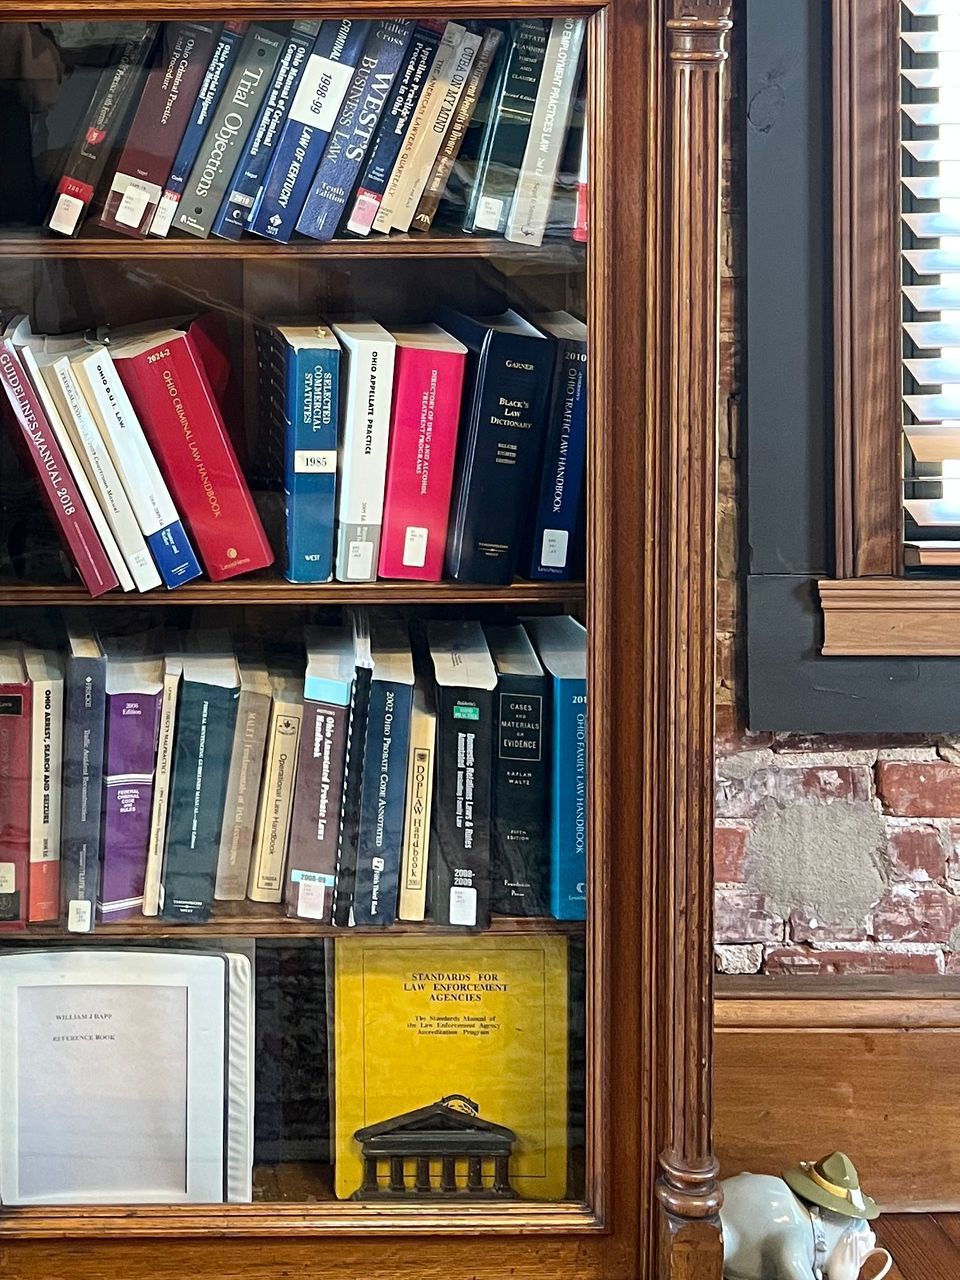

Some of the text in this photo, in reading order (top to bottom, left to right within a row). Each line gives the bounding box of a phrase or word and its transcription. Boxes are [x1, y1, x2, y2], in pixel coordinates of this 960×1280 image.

[208, 41, 224, 71] Practice
[220, 43, 230, 62] Ohio
[328, 18, 352, 62] CRIMINAL
[160, 38, 194, 125] Ohio Criminal Practice
[161, 51, 180, 91] Procedure
[390, 40, 423, 116] Procedure Ohio
[412, 45, 432, 83] Appellate
[249, 42, 296, 156] Complaints and Indictments
[263, 45, 305, 146] Ohio Manual of Criminal
[309, 71, 333, 114] 1998-99
[324, 53, 378, 164] BUSINESS LAW
[431, 45, 474, 134] CUBA ON MY MIND
[538, 31, 569, 152] EMPLOYMENT PRACTICES LAW
[192, 62, 263, 200] Trial Objections
[344, 66, 393, 163] WEST'S
[386, 59, 444, 197] THE AMERICAN LAWYERS QUARTERLY
[277, 125, 312, 208] LAW OF KENTUCKY
[315, 189, 345, 204] Edition
[321, 181, 345, 196] Tenth
[145, 348, 172, 364] 2024-2
[505, 359, 535, 370] GARNER
[564, 352, 587, 362] 2010
[95, 364, 126, 429] OHIO D.U.I. LAW
[301, 372, 314, 424] STATUTES
[310, 365, 324, 431] COMMERCIAL
[320, 371, 332, 424] SELECTED
[367, 374, 376, 415] APPELLATE
[428, 369, 437, 408] DIRECTORY
[499, 397, 529, 409] BLACK'S
[427, 410, 433, 419] OF
[490, 416, 533, 429] DICTIONARY
[504, 408, 522, 417] LAW
[162, 369, 224, 518] OHIO CRIMINAL LAW HANDBOOK
[364, 419, 372, 454] PRACTICE
[416, 390, 428, 474] TREATMENT PROGRAMS
[551, 368, 577, 512] OHIO TRAFFIC LAW HANDBOOK
[31, 430, 64, 488] MANUAL
[55, 486, 76, 516] 2018
[304, 456, 327, 467] 1985
[420, 460, 428, 495] ALCOHOL
[304, 554, 320, 562] WEST
[385, 691, 394, 711] 2002
[510, 703, 533, 712] CASES
[43, 711, 51, 742] ARREST,
[313, 714, 324, 758] Handbook
[501, 721, 540, 730] MATERIALS
[503, 739, 537, 749] EVIDENCE
[318, 716, 334, 817] Ohio Annotated Probate
[465, 732, 474, 765] Domestic
[274, 752, 287, 797] Operational
[378, 773, 388, 797] CODE
[465, 767, 473, 800] Relations
[575, 713, 584, 853] OHIO FAMILY LAW HANDBOOK
[375, 797, 386, 846] ANNOTATED
[464, 801, 473, 819] Laws
[267, 815, 279, 855] Handbook
[464, 828, 472, 848] Rules
[404, 983, 509, 992] LAW ENFORCEMENT
[412, 973, 499, 981] STANDARDS FOR
[430, 993, 482, 1002] AGENCIES
[52, 1034, 93, 1042] REFERENCE
